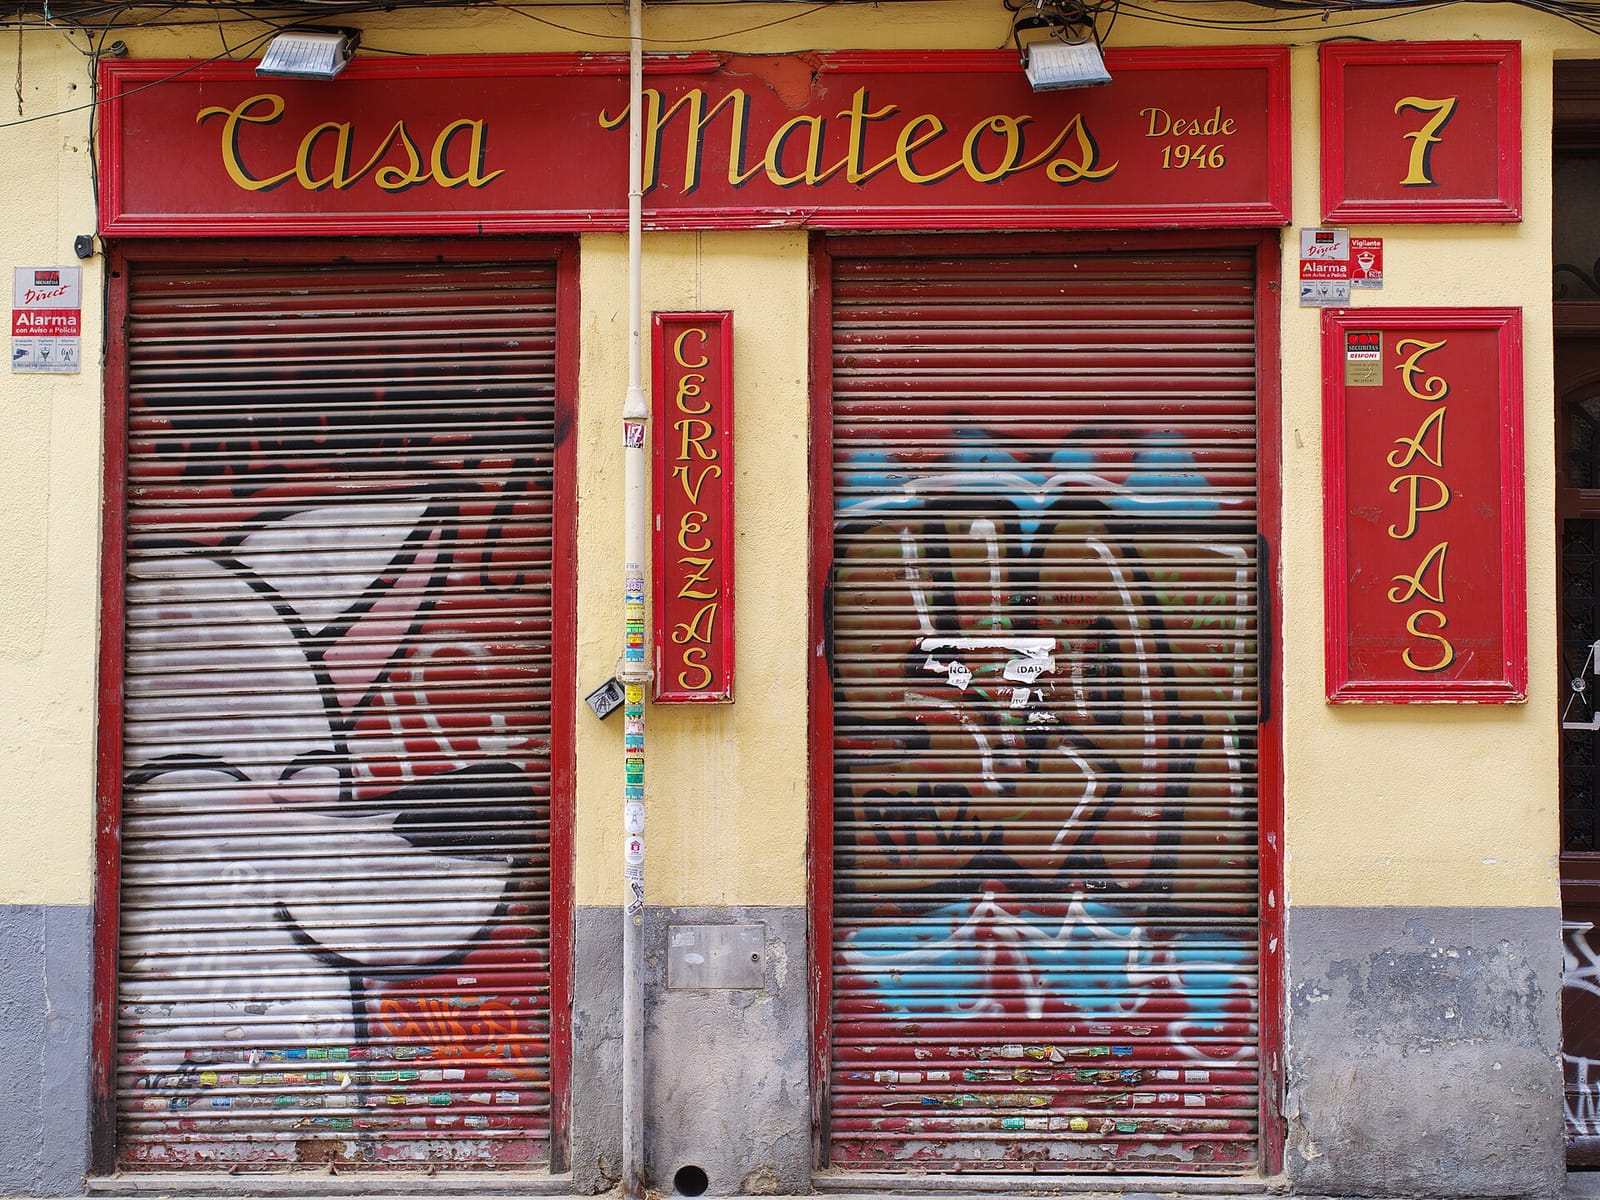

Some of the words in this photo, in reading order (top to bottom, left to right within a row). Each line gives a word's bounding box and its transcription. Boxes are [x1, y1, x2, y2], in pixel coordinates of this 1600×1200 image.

[1140, 106, 1237, 137] Desde
[196, 94, 504, 192] Casa
[599, 86, 1119, 195] Mateos
[1394, 96, 1457, 187] 7
[1161, 144, 1226, 169] 1946
[1307, 242, 1342, 257] Direct
[1351, 239, 1381, 248] Vigilante
[1302, 262, 1347, 272] Alarma
[24, 284, 71, 305] Direct
[16, 312, 77, 326] Alarma
[29, 326, 48, 334] Aviso
[672, 328, 721, 690] CERVEZAS
[1386, 338, 1457, 673] TAPAS
